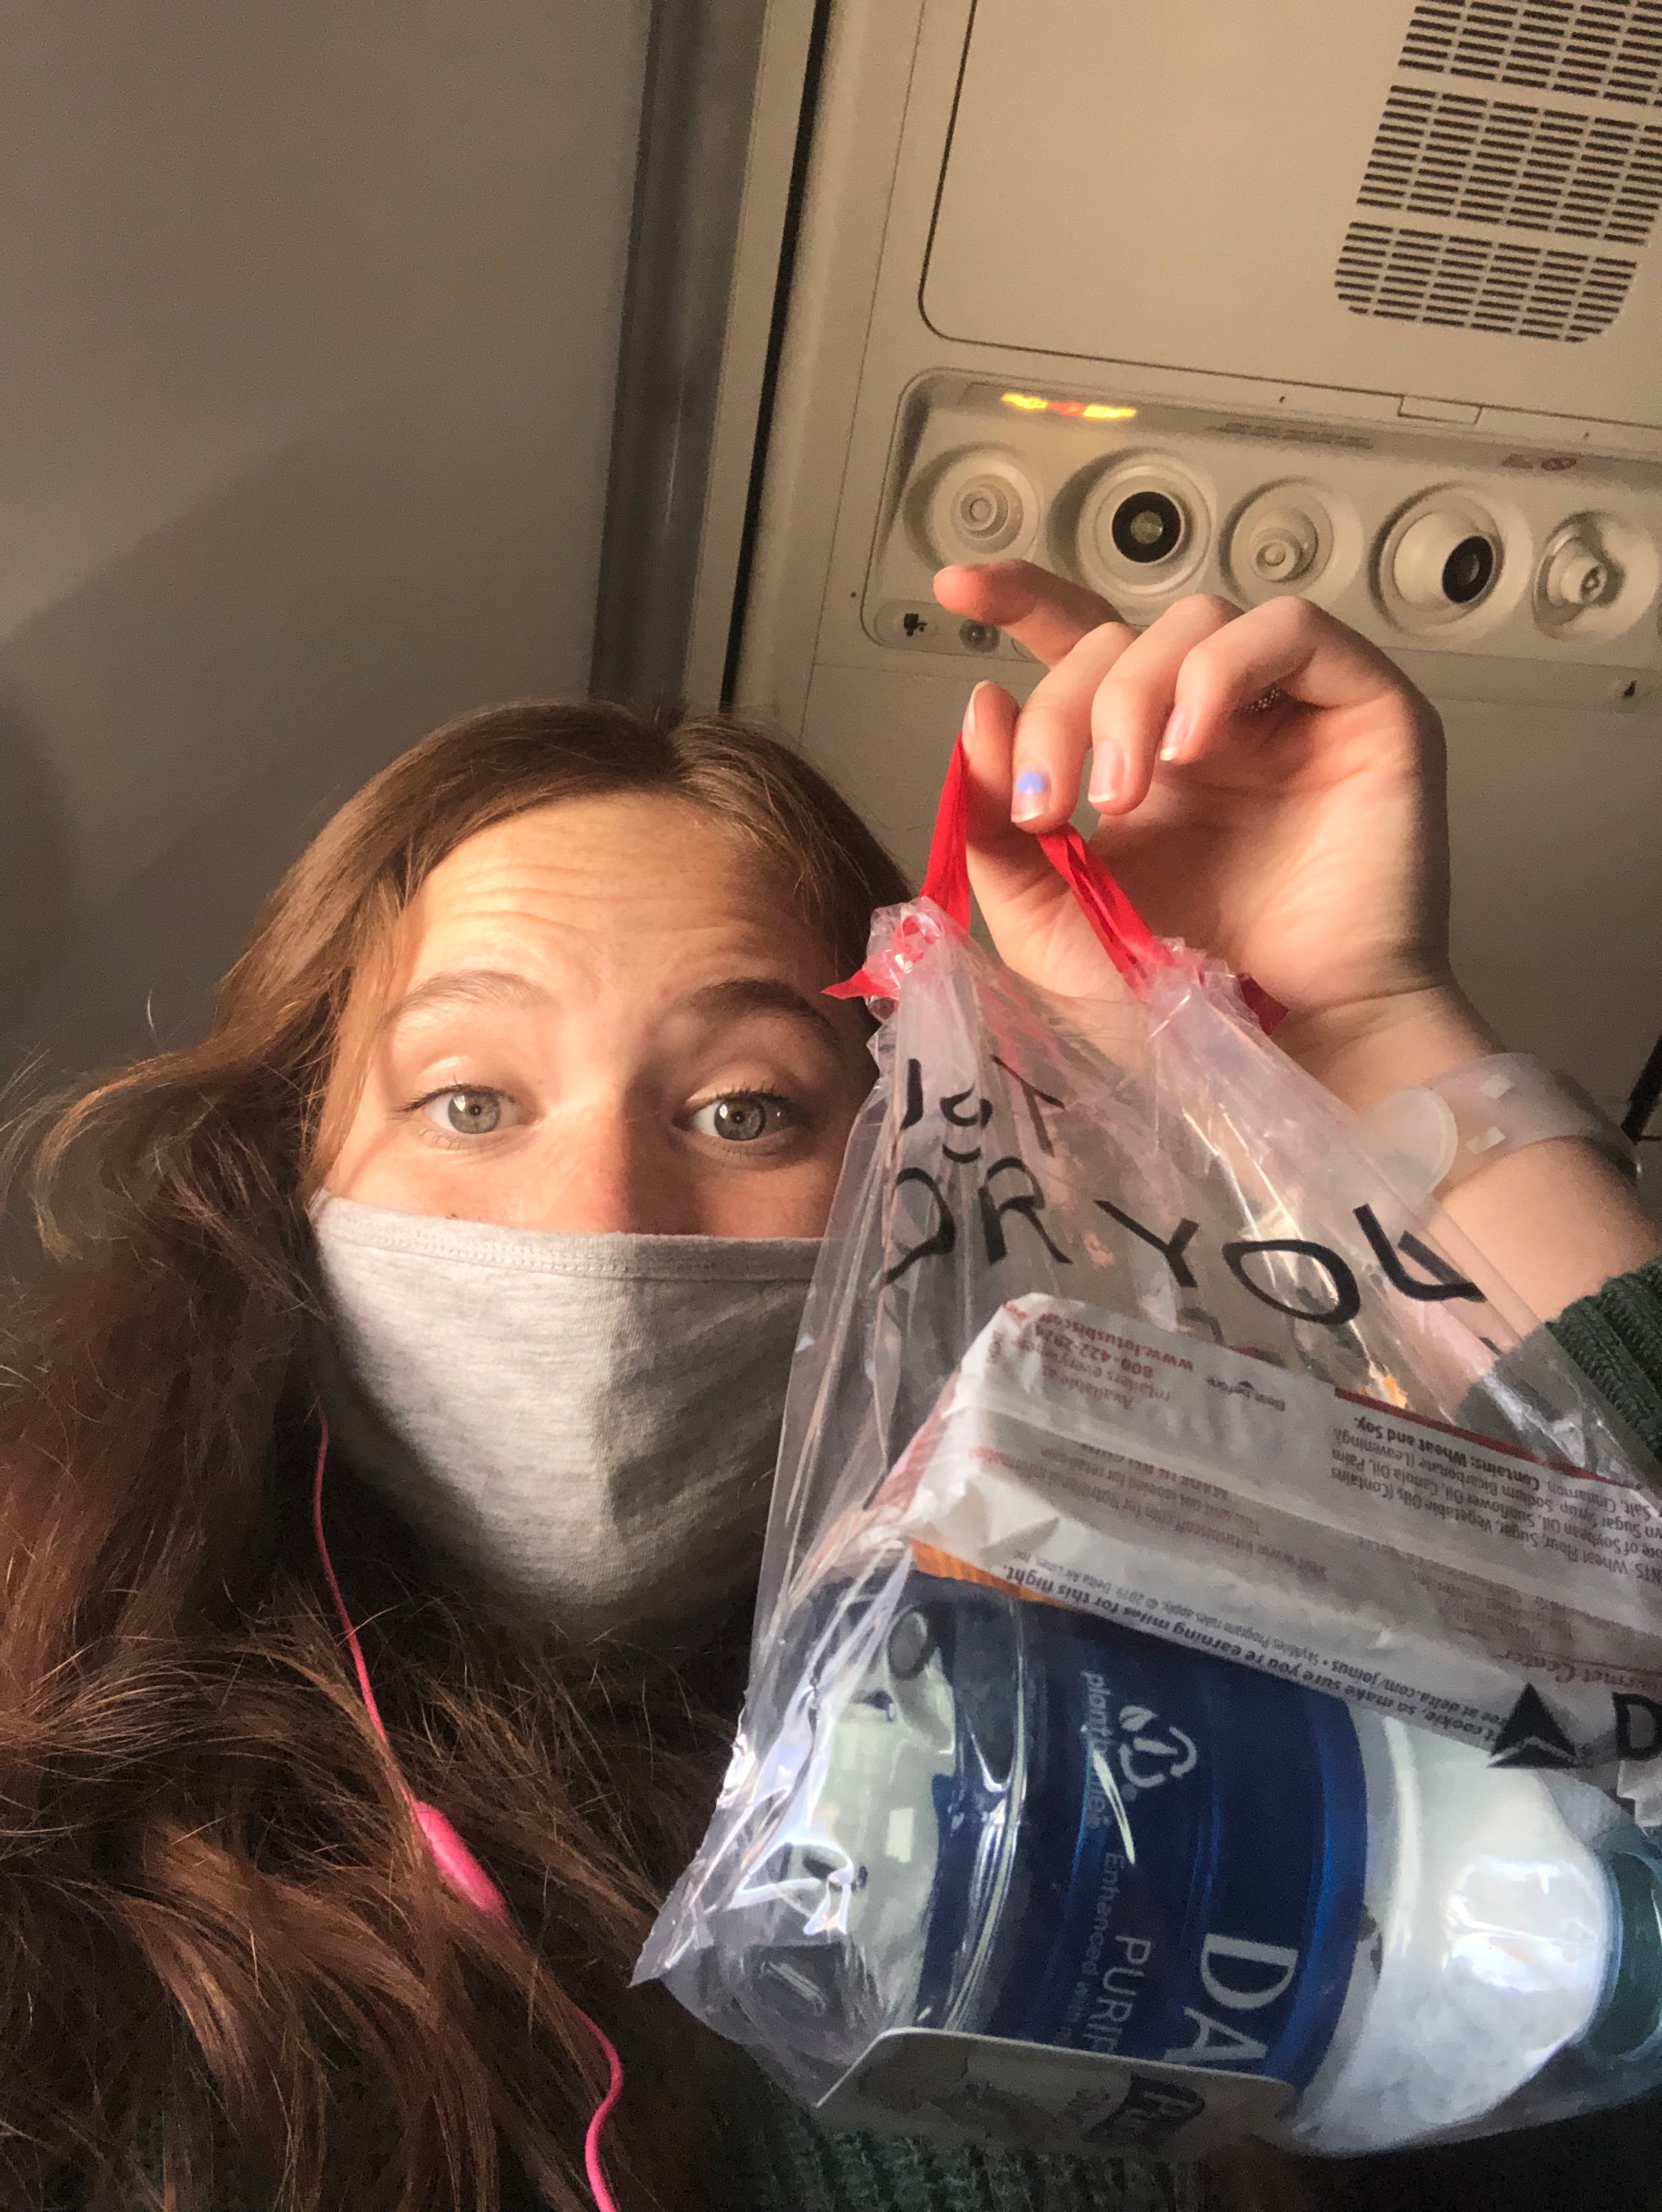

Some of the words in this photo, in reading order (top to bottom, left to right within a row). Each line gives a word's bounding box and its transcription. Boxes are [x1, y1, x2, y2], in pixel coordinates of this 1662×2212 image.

[1351, 1415, 1386, 1439] Soy.
[1384, 1428, 1416, 1448] and
[1417, 1438, 1469, 1466] Wheat
[999, 1561, 1055, 1594] flight.
[1056, 1584, 1090, 1605] this
[1092, 1596, 1119, 1615] for
[1122, 1607, 1170, 1630] miles
[1171, 1620, 1244, 1657] earning
[1243, 1648, 1300, 1677] you're
[1301, 1670, 1341, 1691] sure
[1342, 1684, 1393, 1708] make
[1397, 1701, 1416, 1715] so
[1080, 1852, 1126, 1976] Enhanced
